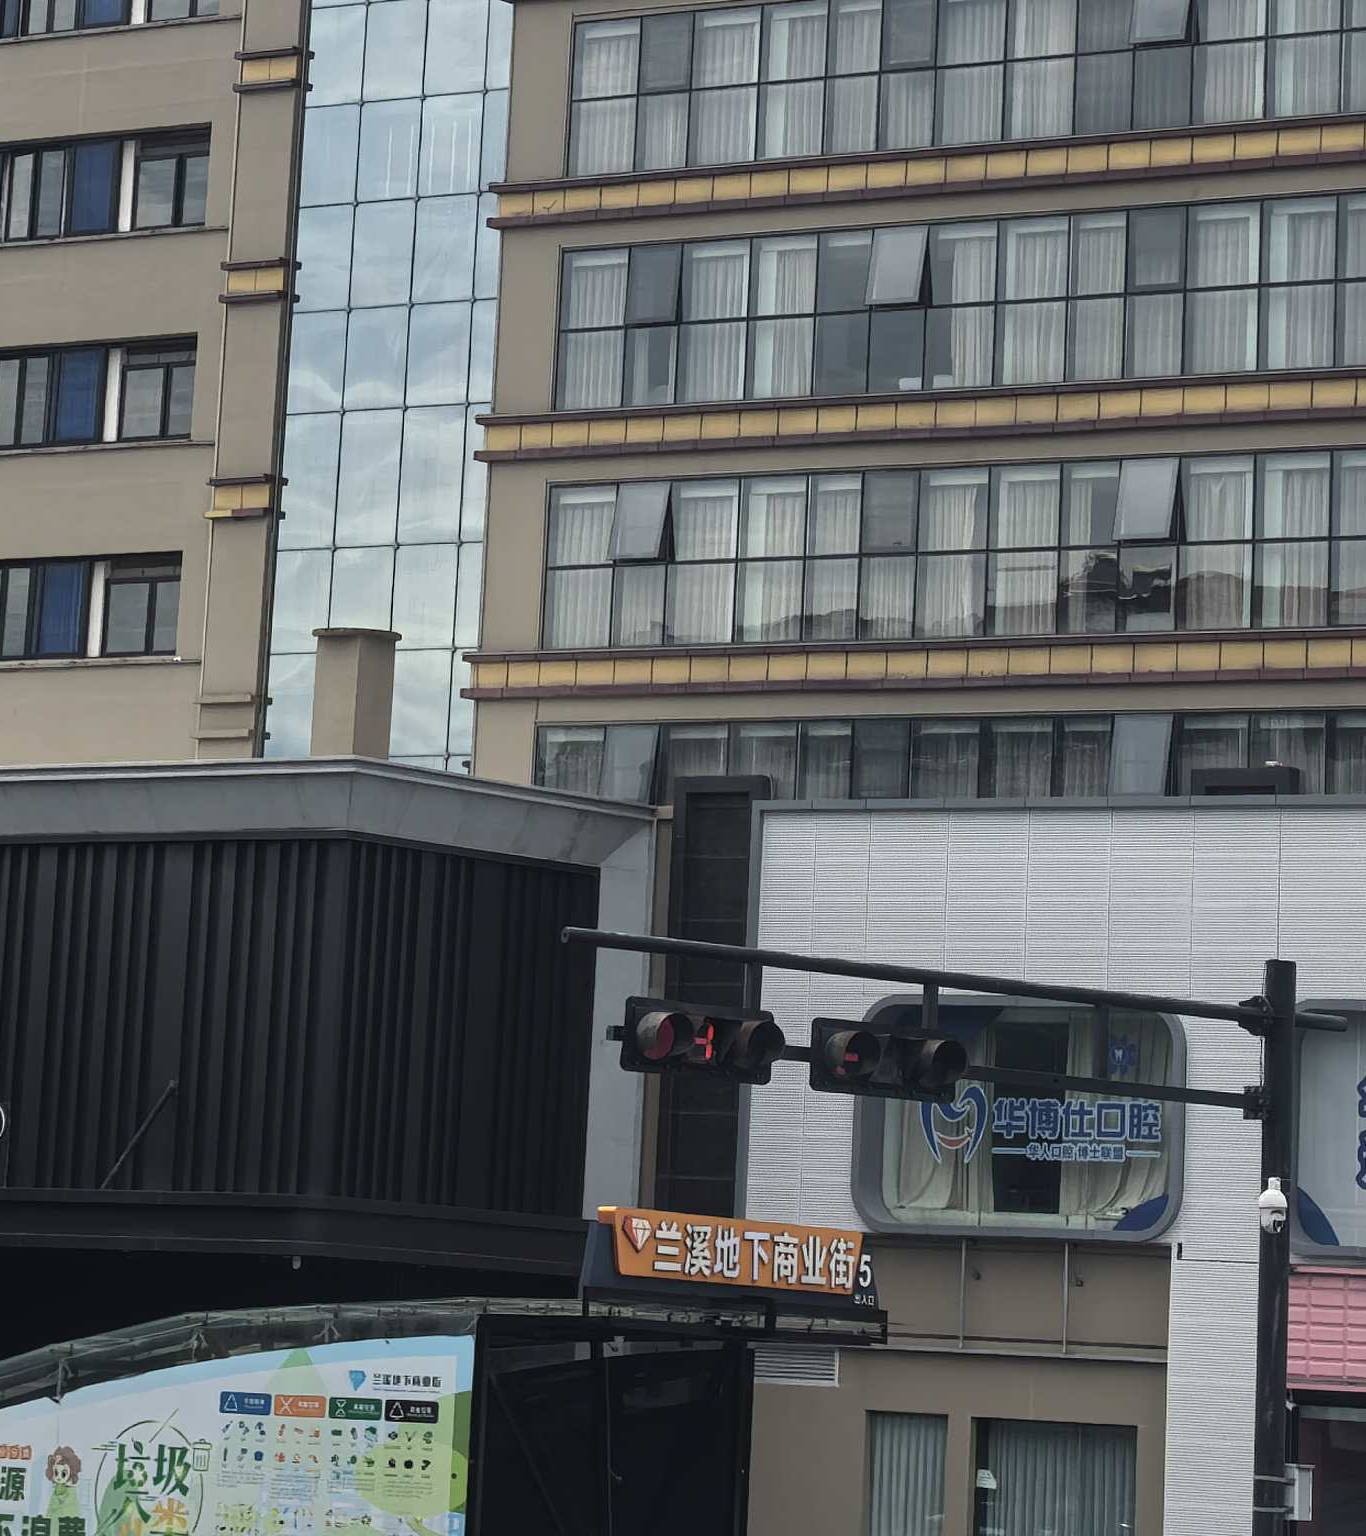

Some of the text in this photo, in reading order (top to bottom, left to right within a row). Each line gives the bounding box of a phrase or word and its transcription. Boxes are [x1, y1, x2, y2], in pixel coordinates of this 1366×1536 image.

[992, 1097, 1163, 1142] 华博仕口腔
[653, 1220, 872, 1289] 兰溪地下商业街 5
